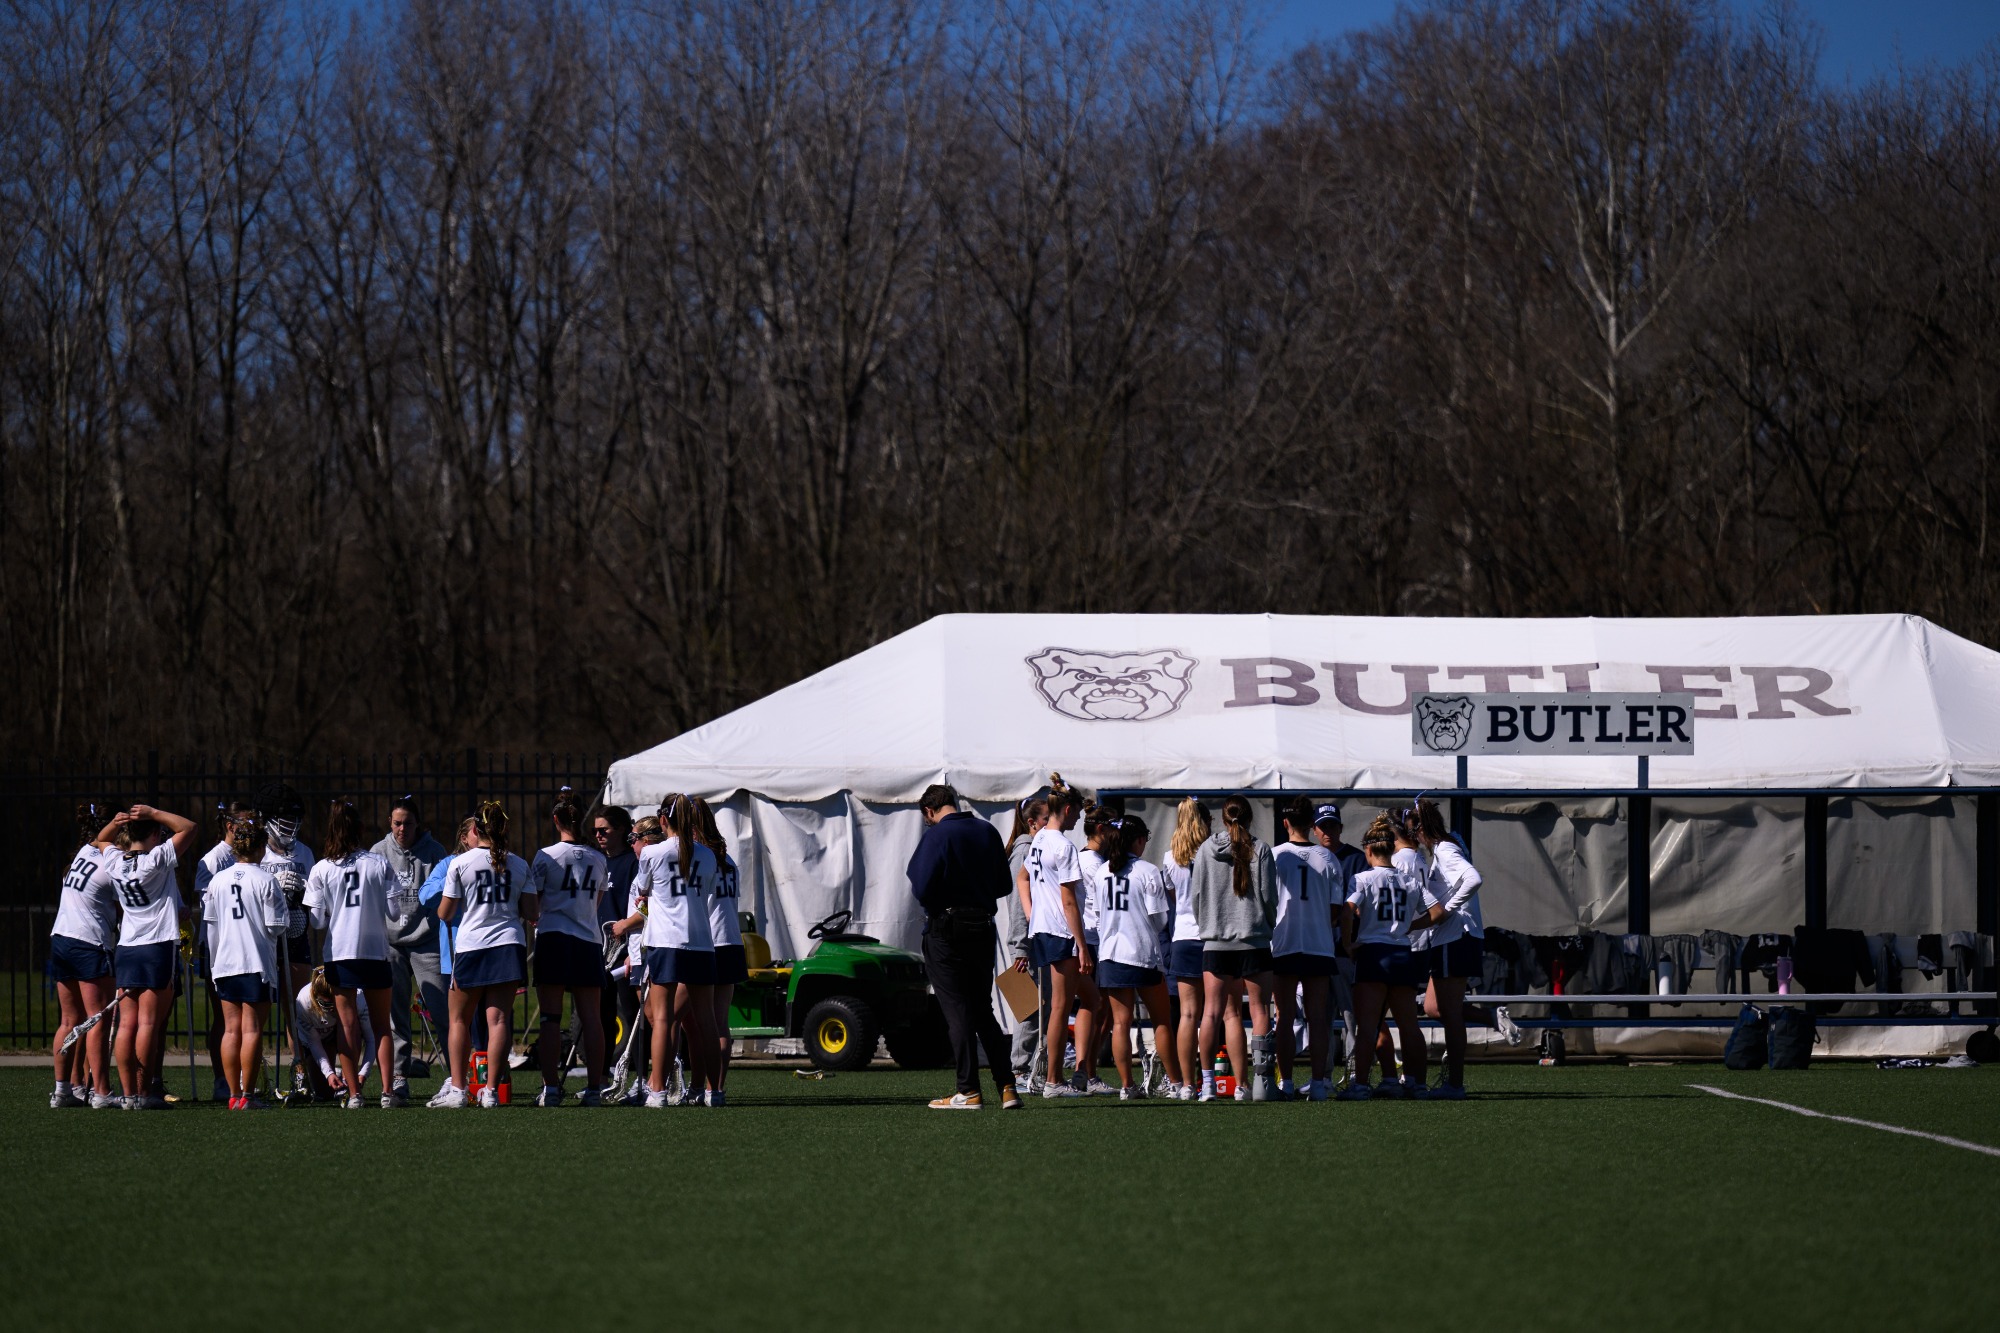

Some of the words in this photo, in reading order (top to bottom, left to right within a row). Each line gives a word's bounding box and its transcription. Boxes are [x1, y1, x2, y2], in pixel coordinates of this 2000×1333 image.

[1486, 704, 1691, 743] BUTLER
[65, 858, 98, 891] 29
[345, 871, 360, 907] 2
[476, 869, 512, 904] 28
[561, 864, 597, 899] 44
[669, 860, 702, 897] 24
[1297, 865, 1309, 901] 1
[231, 884, 244, 920] 3
[1107, 876, 1129, 910] 12
[1377, 887, 1407, 922] 22
[399, 914, 409, 927] 16
[1216, 1080, 1226, 1093] G
